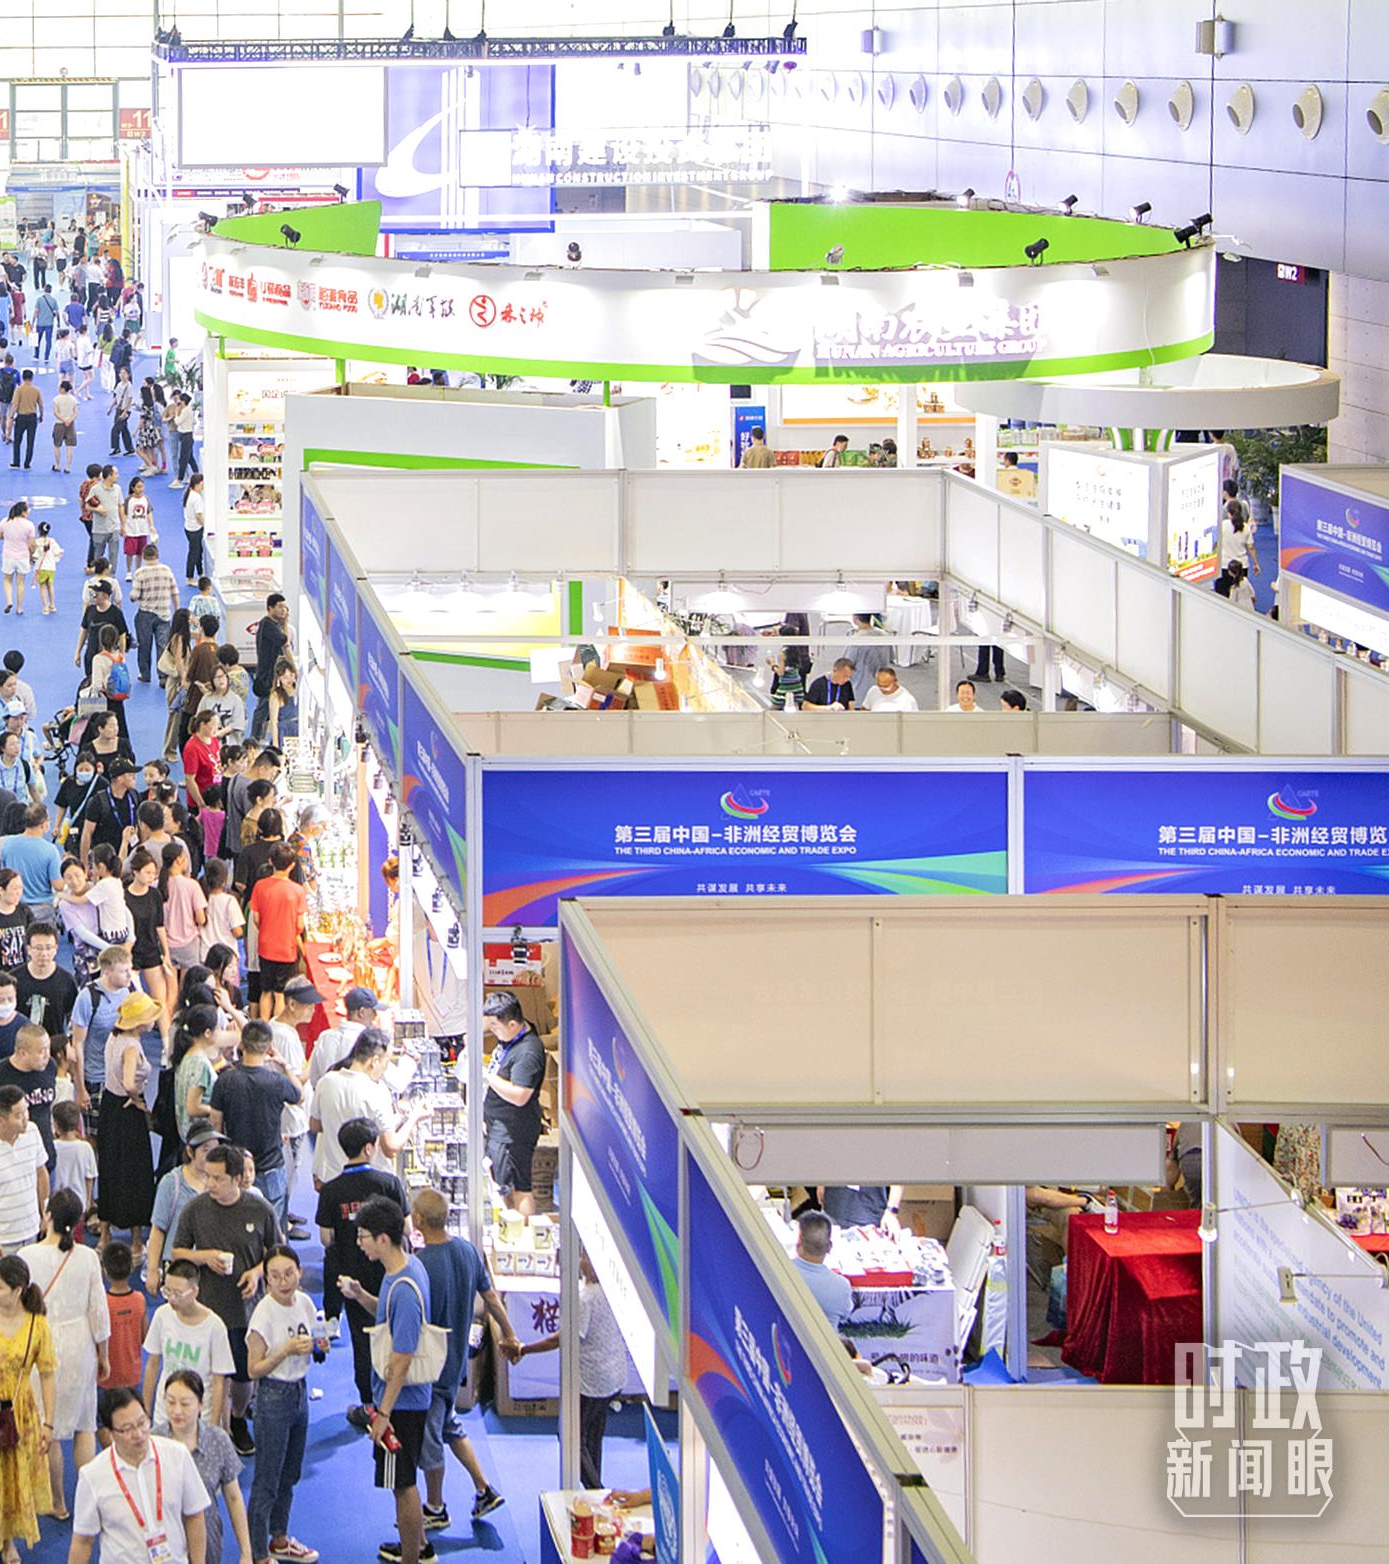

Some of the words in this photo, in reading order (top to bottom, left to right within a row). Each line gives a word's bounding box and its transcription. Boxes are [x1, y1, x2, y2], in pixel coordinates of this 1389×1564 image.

[614, 824, 857, 844] 第三届中国-非洲经贸博览会
[1158, 825, 1388, 845] 第三届中国-非洲经贸博览
[614, 846, 633, 855] THE
[634, 846, 662, 855] THIRD
[662, 846, 728, 855] CHINA-AFRICA
[728, 846, 777, 855] ECONOMIC
[778, 846, 798, 855] AND
[799, 846, 830, 855] TRADE
[831, 846, 857, 855] EXPO
[1157, 847, 1177, 856] THE
[1178, 847, 1207, 856] THIRD
[1207, 847, 1275, 856] CHINA-AFRICA
[1275, 847, 1326, 856] ECONOMIC
[1327, 847, 1348, 856] AND
[1349, 847, 1379, 856] TRADE
